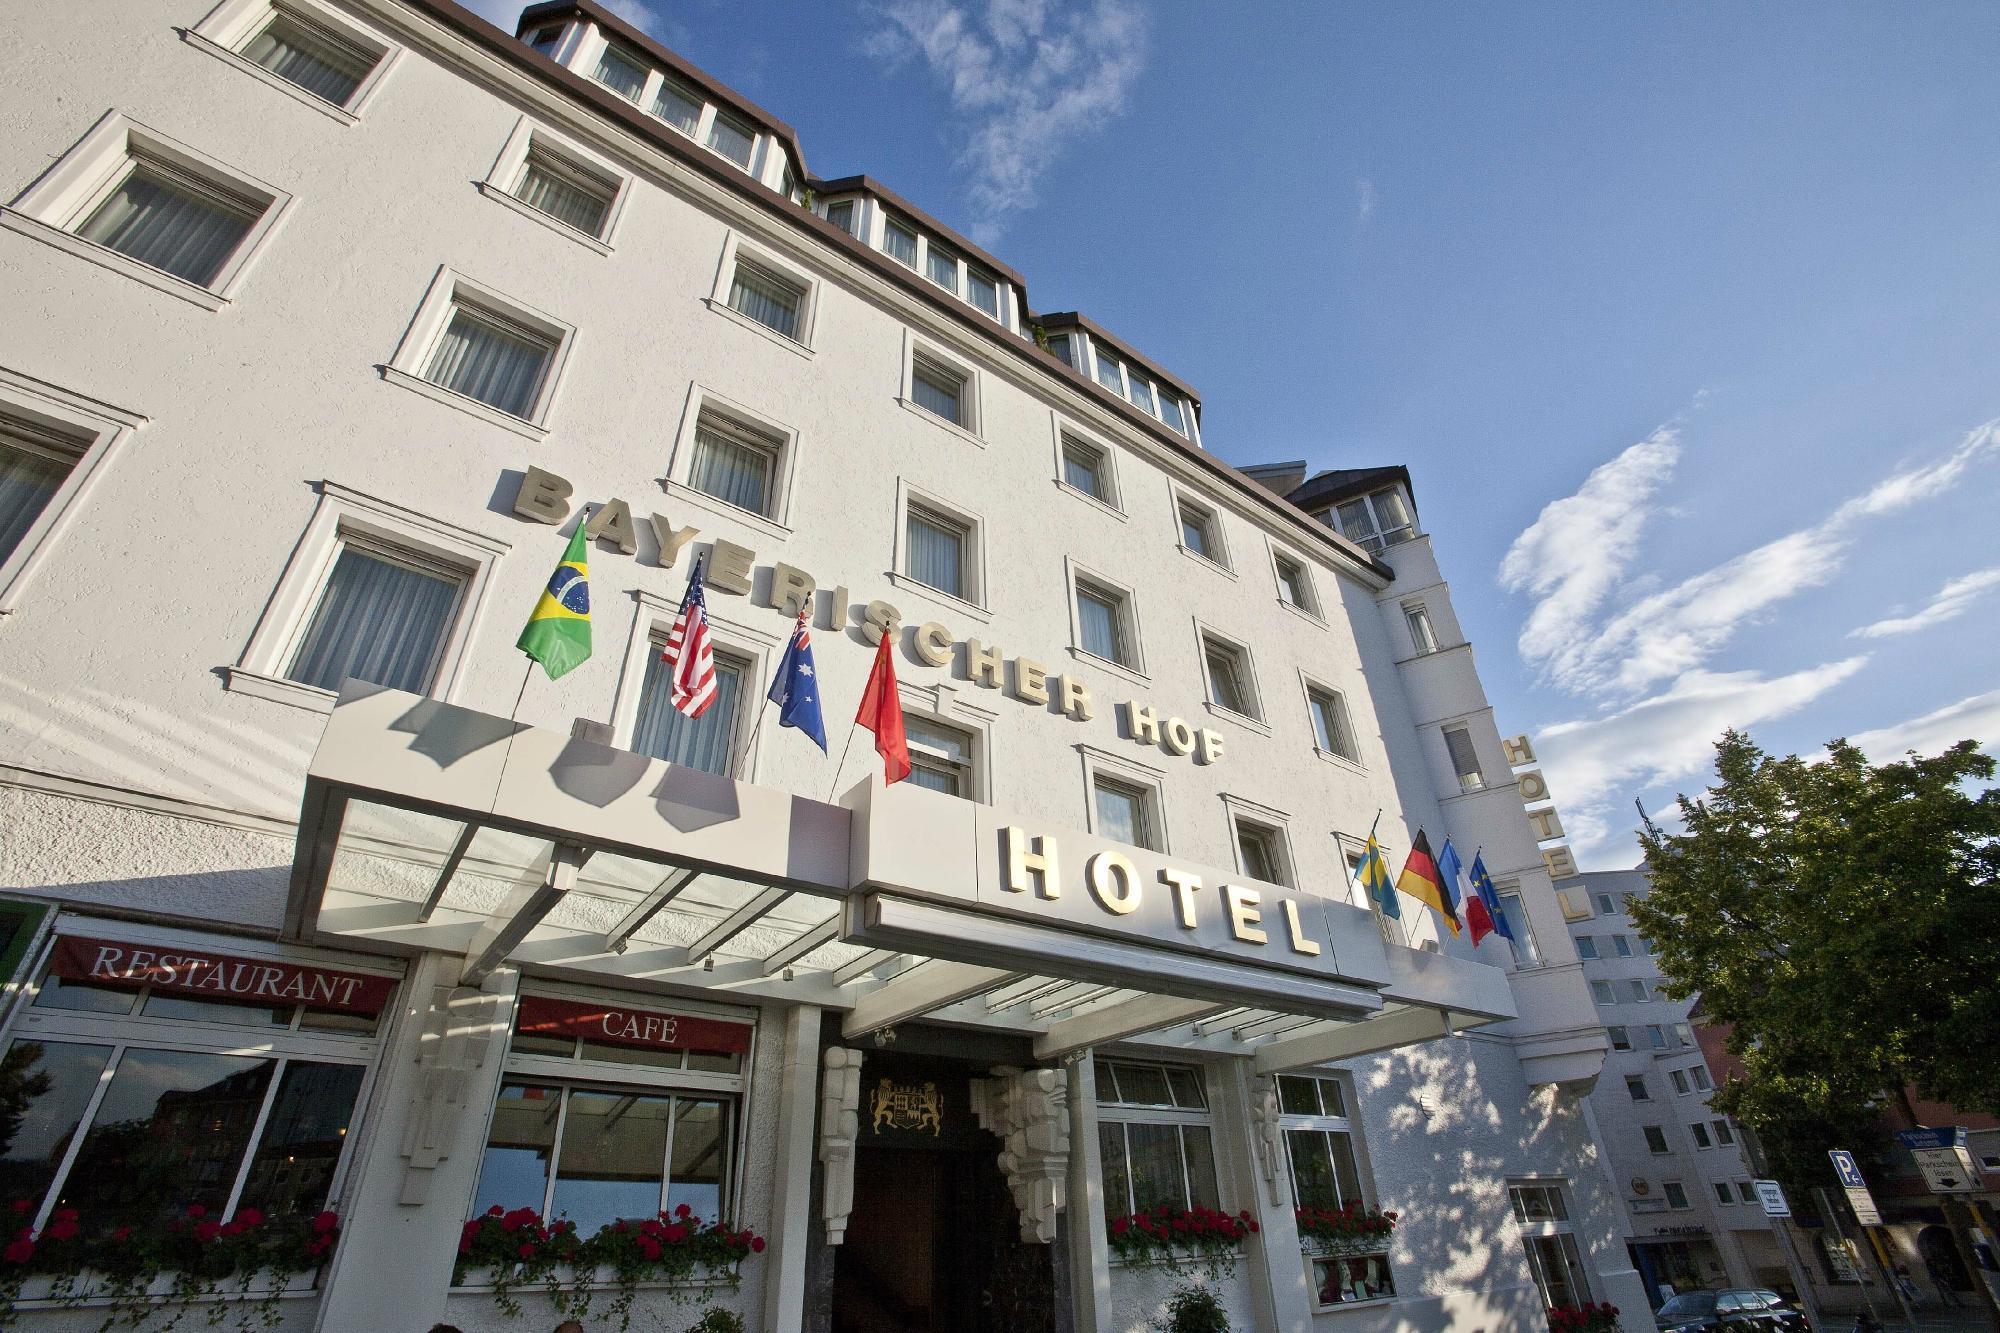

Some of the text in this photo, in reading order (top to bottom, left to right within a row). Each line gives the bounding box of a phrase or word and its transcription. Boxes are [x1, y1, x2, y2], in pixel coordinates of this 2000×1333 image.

[513, 465, 1225, 765] BAYERISCHER HOF
[1503, 735, 1589, 920] HOTEL
[1006, 826, 1321, 956] HOTEL
[88, 946, 364, 1005] RESTAURANT
[602, 1011, 678, 1044] CAFÉ
[1835, 1155, 1852, 1183] P
